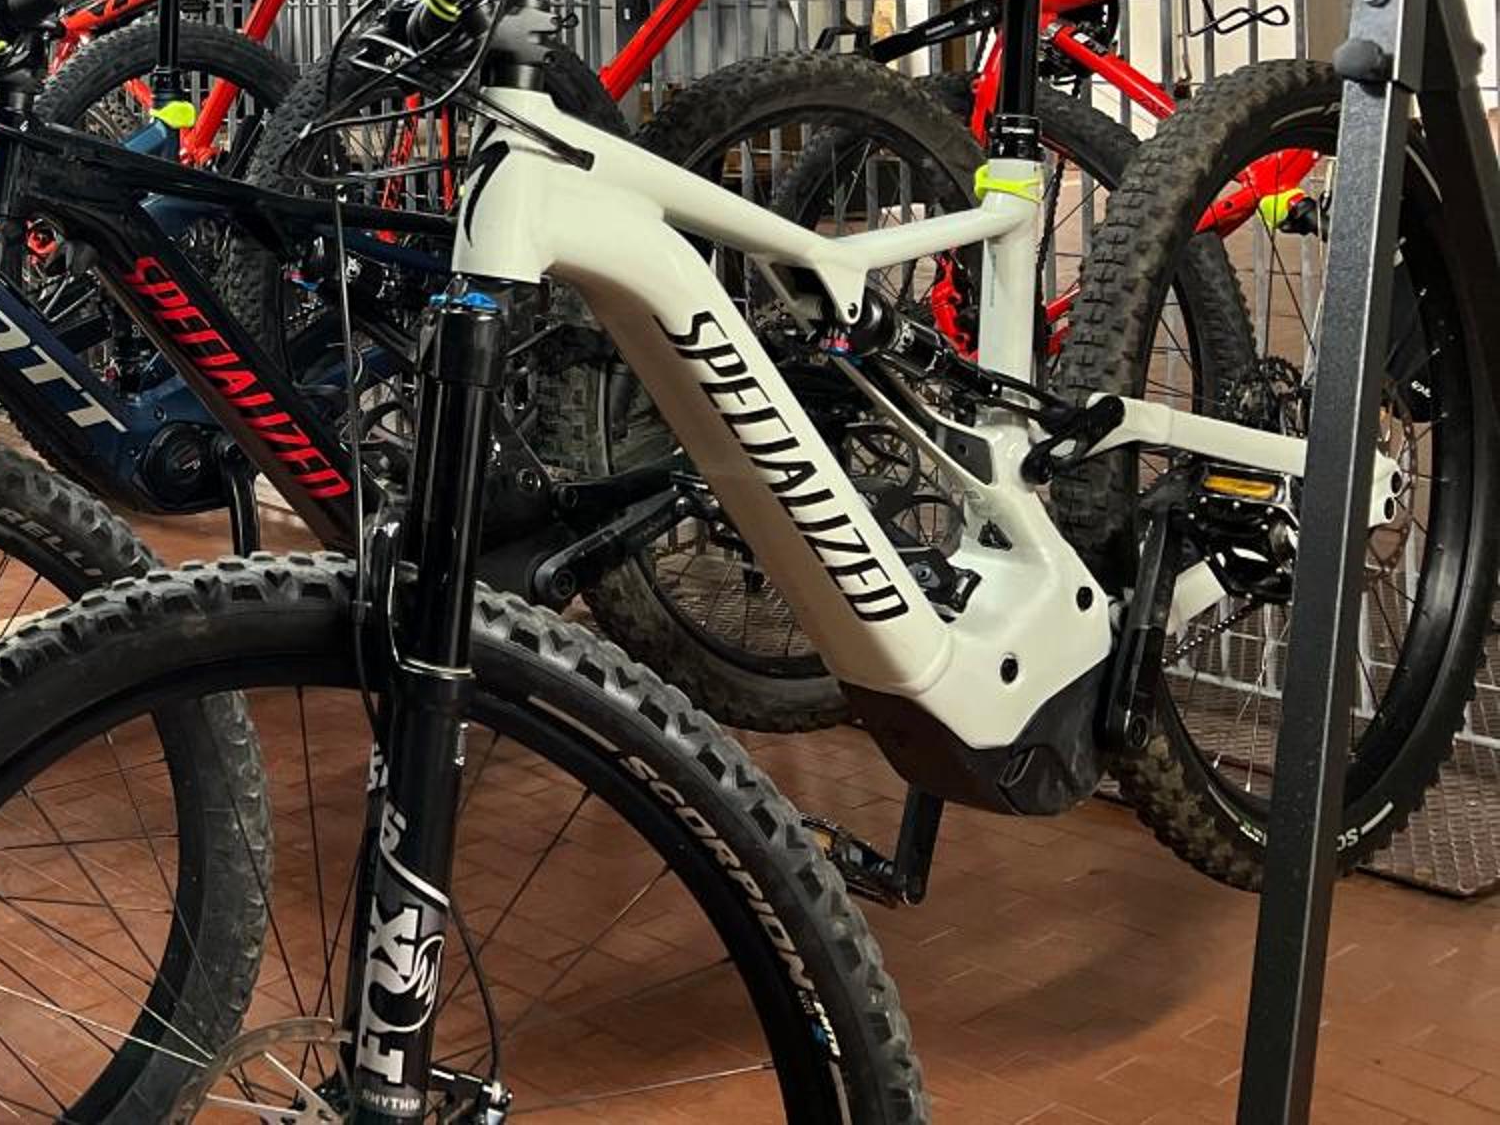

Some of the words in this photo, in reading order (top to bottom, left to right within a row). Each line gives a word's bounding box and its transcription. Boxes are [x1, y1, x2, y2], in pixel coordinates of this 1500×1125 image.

[121, 255, 351, 499] SPECIALIZED
[654, 309, 910, 624] SPECIALIZED
[355, 896, 445, 1085] FOX
[618, 755, 816, 992] SCORPION
